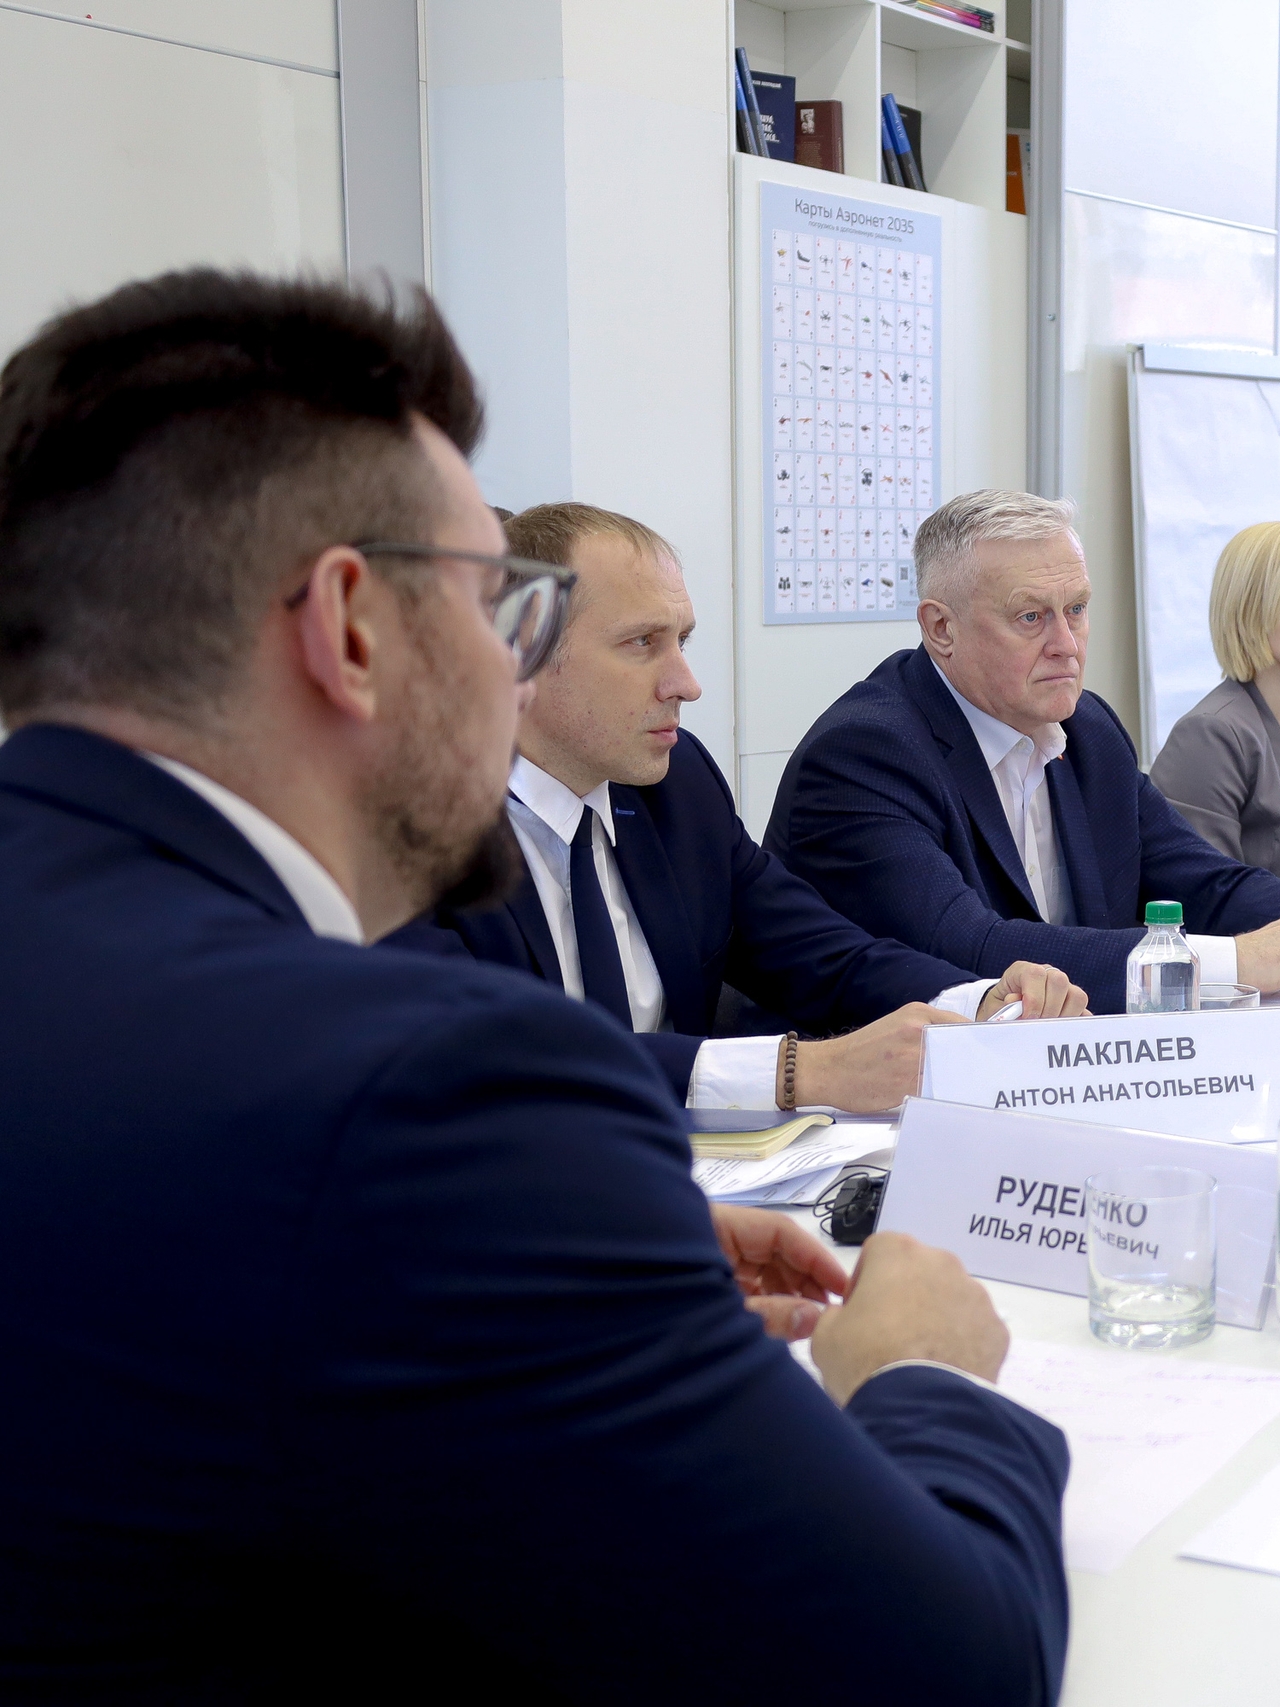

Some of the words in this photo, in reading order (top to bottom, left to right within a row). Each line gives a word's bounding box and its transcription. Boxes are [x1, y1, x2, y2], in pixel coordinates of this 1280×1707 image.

[794, 198, 832, 219] Карты
[836, 206, 885, 227] Аэронет
[887, 216, 915, 234] 2035
[1047, 1036, 1197, 1069] МАКЛАЕВ
[994, 1086, 1076, 1109] АНТОН
[1082, 1074, 1255, 1103] АНАТОЛЬЕВИЧ
[996, 1175, 1149, 1228] РУДЕНКО
[969, 1213, 1034, 1244] ИЛЬЯ
